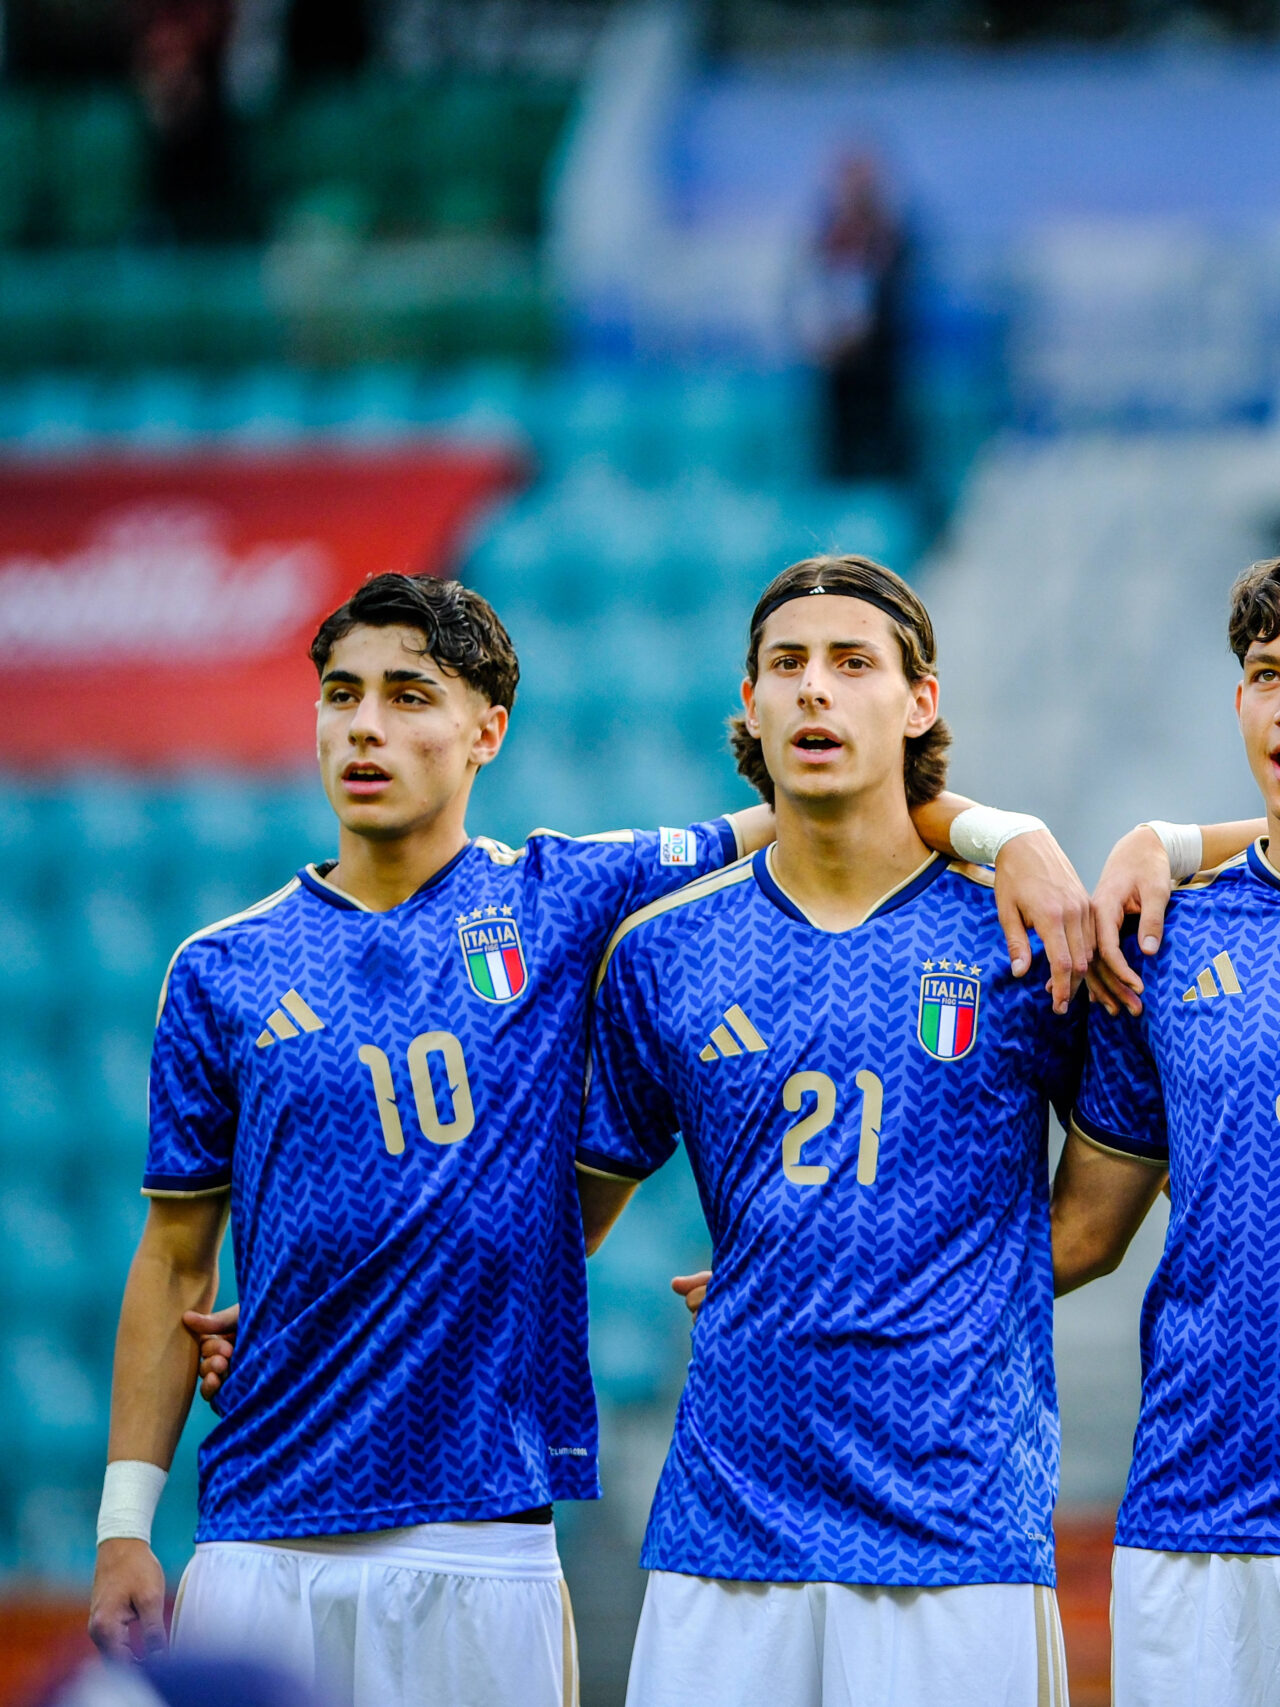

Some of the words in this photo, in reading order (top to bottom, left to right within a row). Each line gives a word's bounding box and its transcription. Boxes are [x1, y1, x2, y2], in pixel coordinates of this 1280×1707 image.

[463, 925, 515, 948] ITALIA
[924, 979, 975, 1001] ITALIA
[359, 1031, 475, 1155] 10
[782, 1070, 883, 1185] 21
